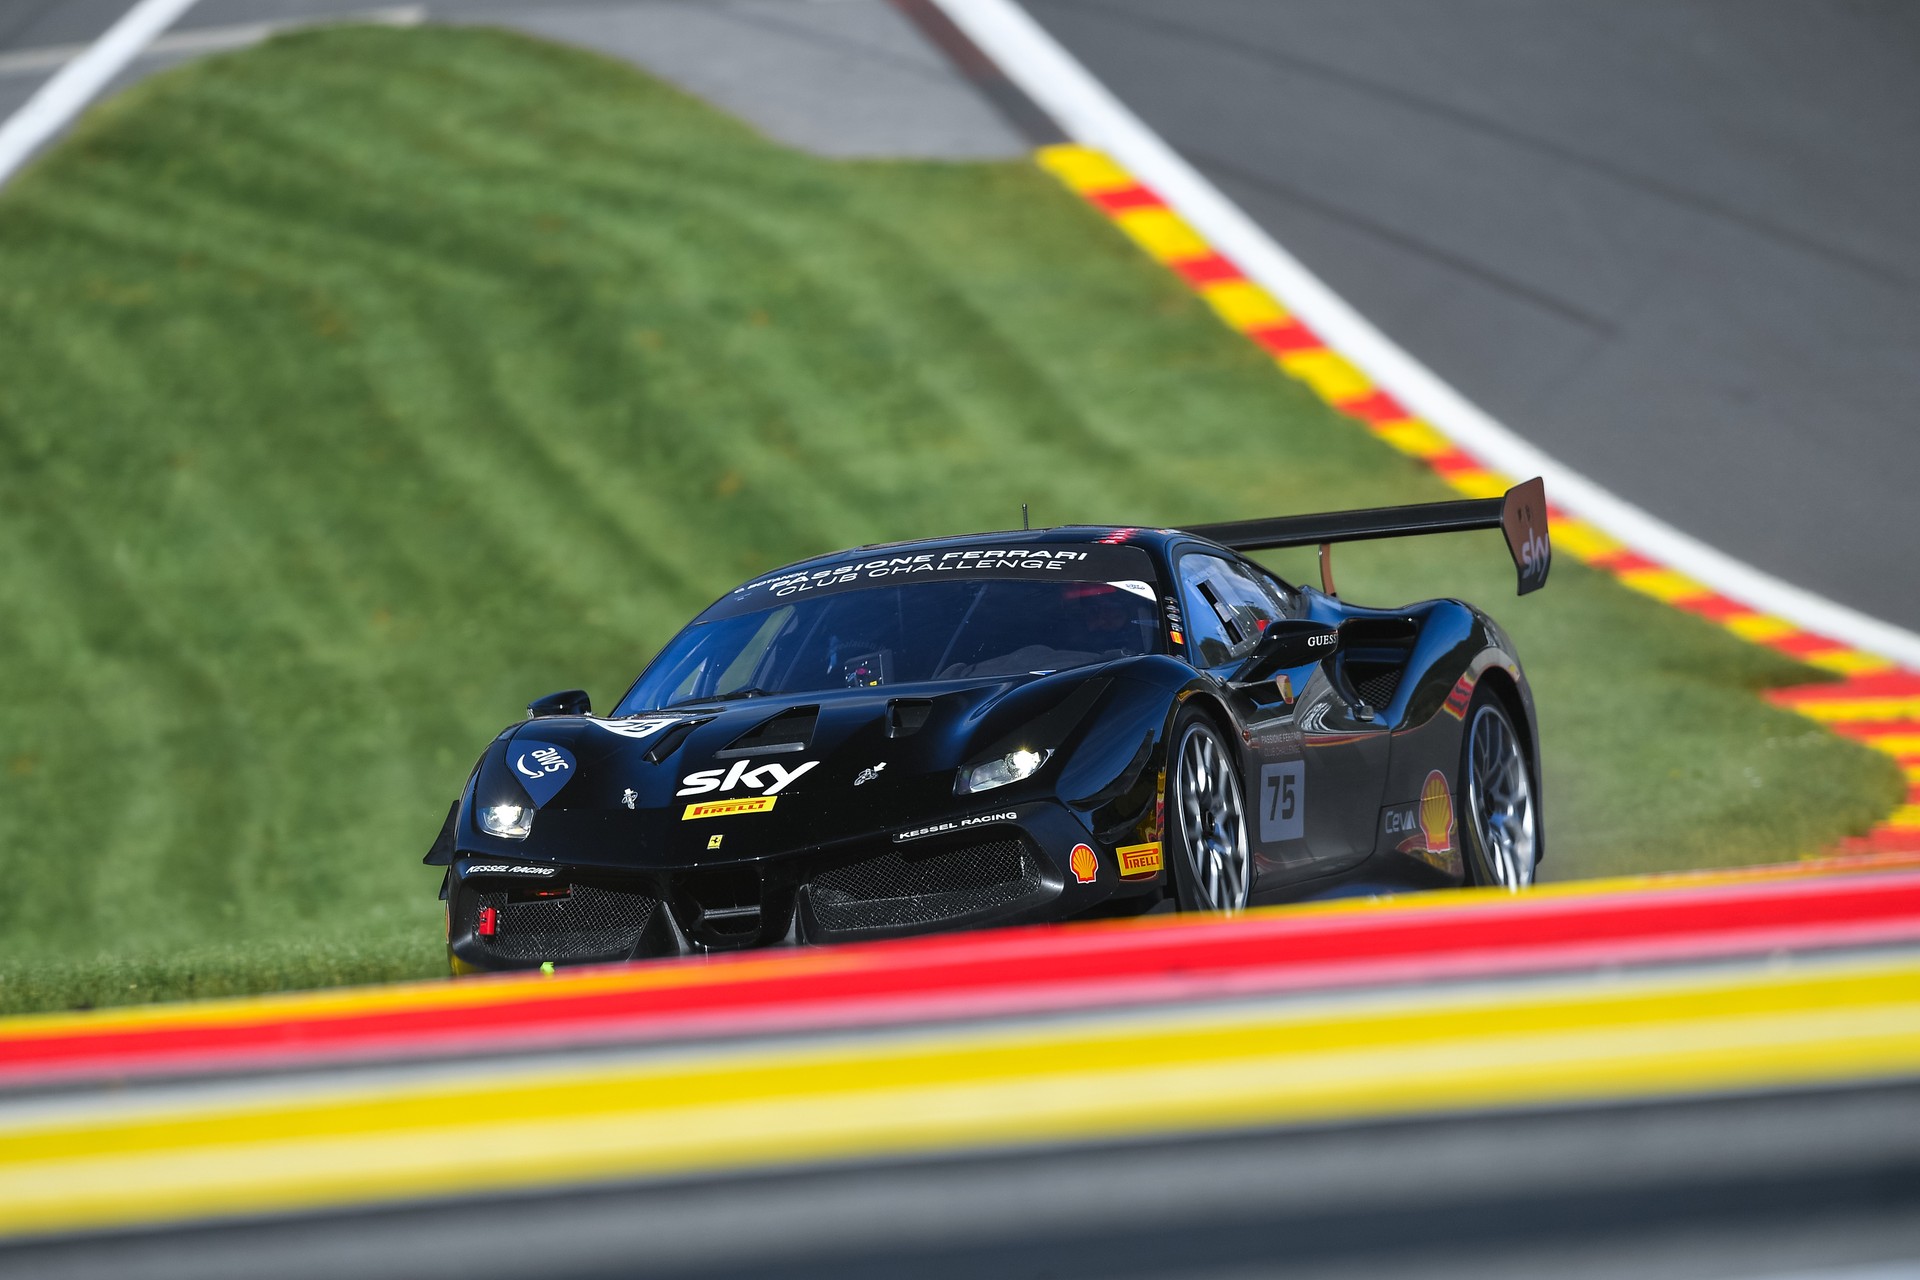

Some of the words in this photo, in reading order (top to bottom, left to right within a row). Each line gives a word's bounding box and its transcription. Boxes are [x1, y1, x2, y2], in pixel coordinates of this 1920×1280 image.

[769, 554, 935, 591] PASSIONE
[941, 550, 1088, 561] FERRARI
[776, 572, 858, 597] CLUB
[868, 559, 1066, 578] CHALLENGE
[1307, 633, 1337, 647] GUESS
[531, 747, 569, 772] aws
[676, 759, 820, 796] sky
[693, 799, 767, 816] PIRELLI
[1267, 774, 1295, 821] 75
[899, 822, 958, 840] KESSEL
[961, 811, 1018, 827] RACING
[465, 865, 509, 875] KESSEL
[508, 865, 555, 875] RACING
[1122, 847, 1159, 870] PIRELLI
